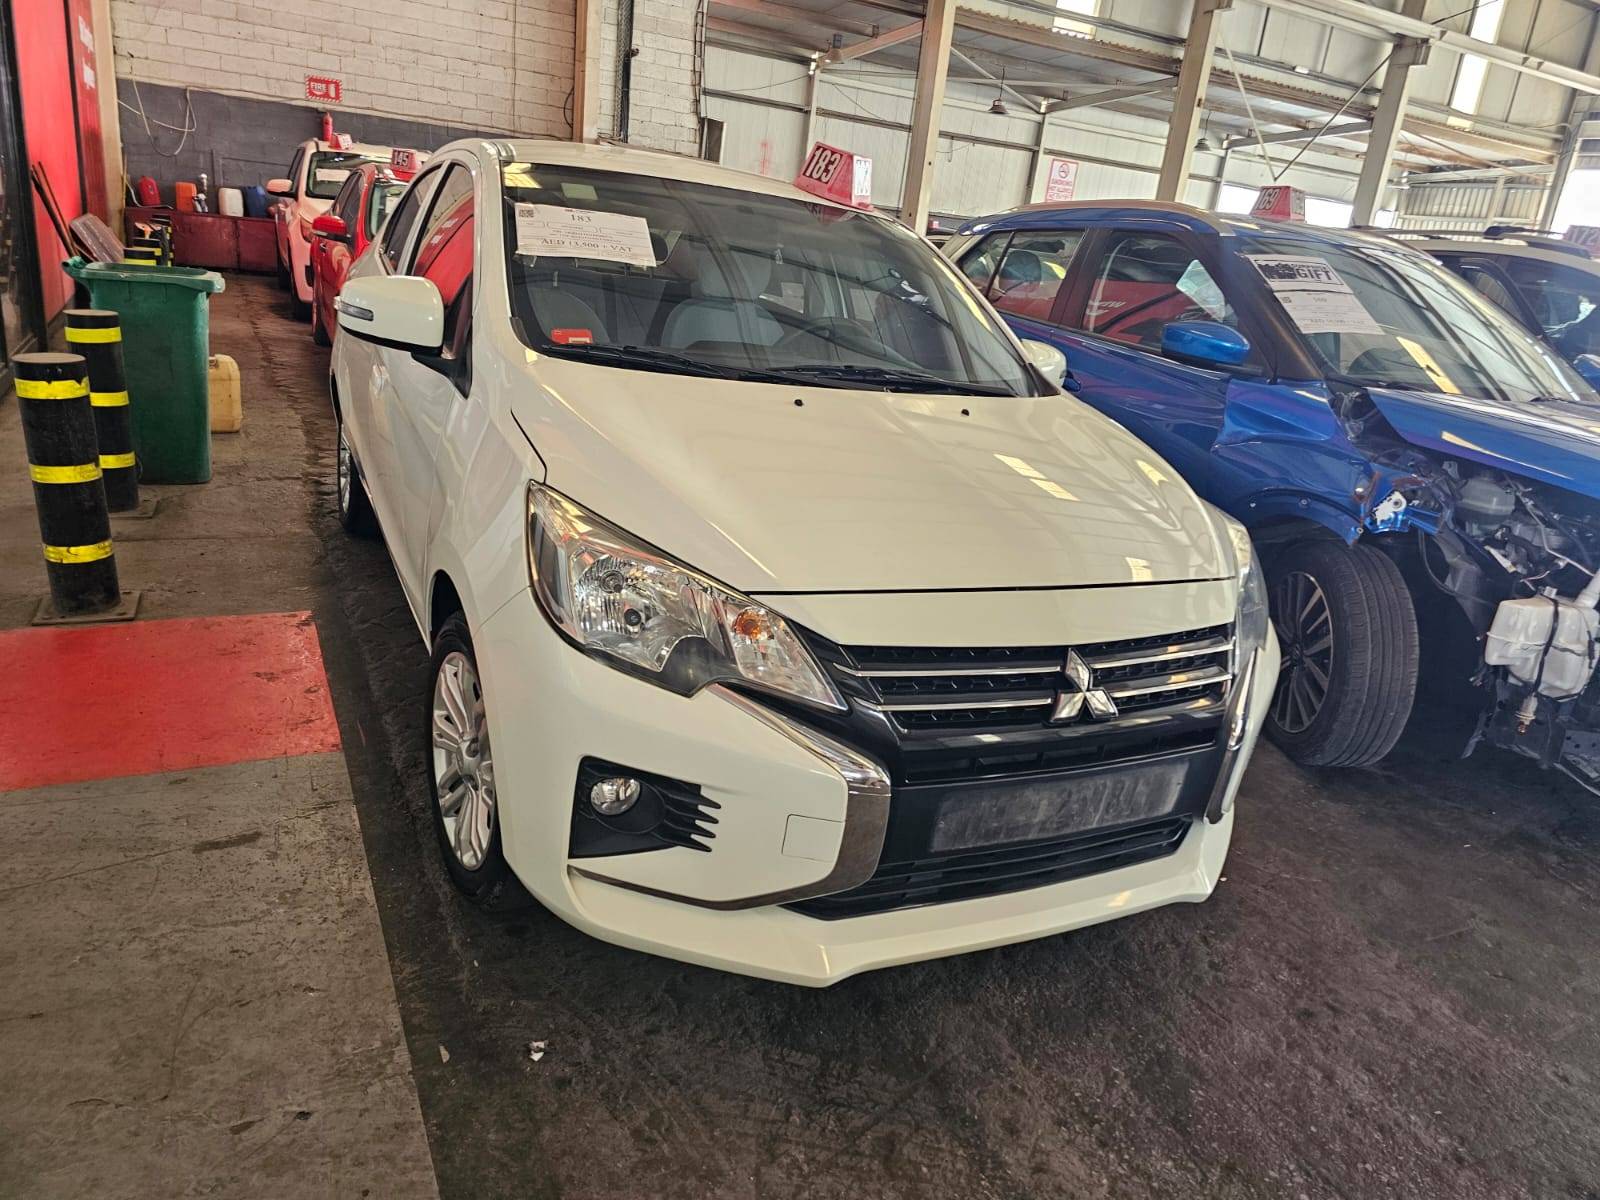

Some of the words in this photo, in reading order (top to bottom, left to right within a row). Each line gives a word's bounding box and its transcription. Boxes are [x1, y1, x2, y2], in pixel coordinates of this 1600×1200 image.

[310, 81, 328, 92] FIRE
[393, 149, 410, 166] 145
[805, 146, 842, 184] 183
[1255, 187, 1281, 210] 169
[571, 214, 592, 223] 183
[541, 238, 565, 246] AED
[610, 244, 633, 253] VAT
[1295, 268, 1332, 281] GIFT
